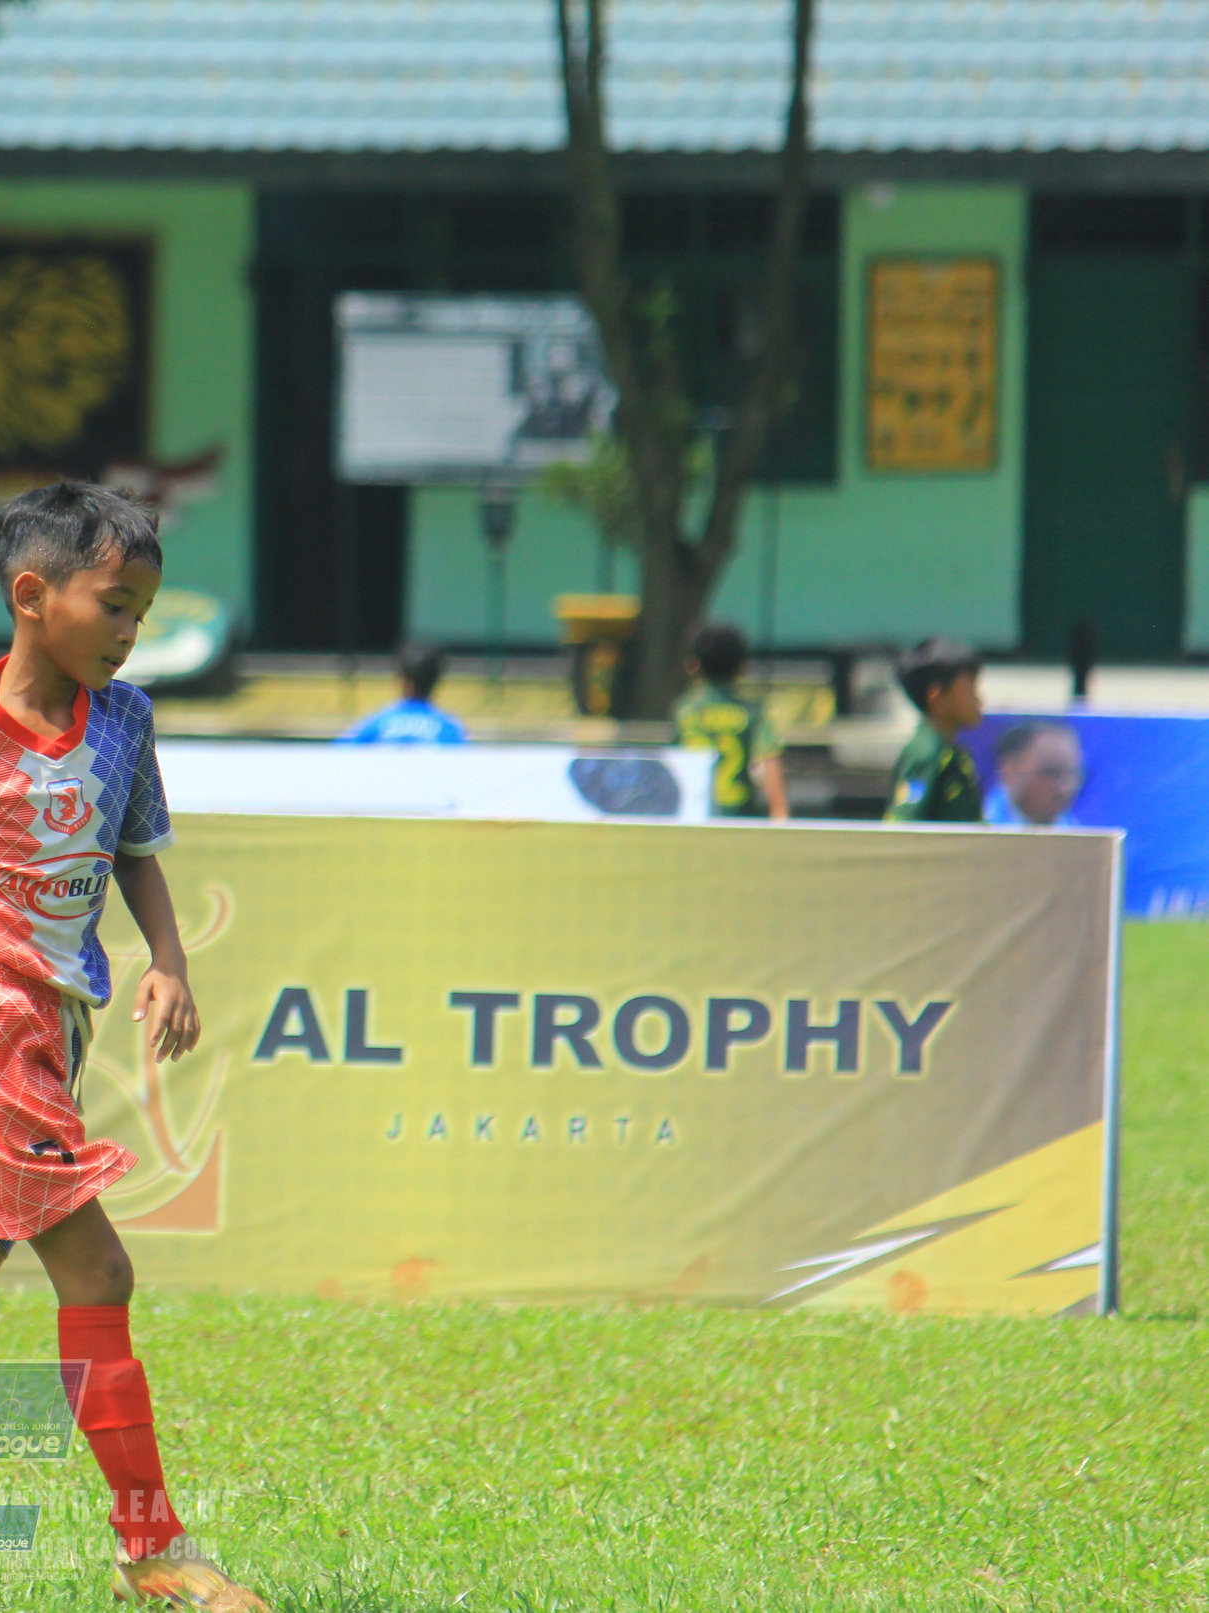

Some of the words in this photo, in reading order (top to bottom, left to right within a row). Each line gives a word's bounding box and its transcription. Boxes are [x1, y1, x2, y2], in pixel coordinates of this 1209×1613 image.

[252, 987, 403, 1063] AL
[450, 990, 954, 1075] TROPHY
[384, 1111, 679, 1147] JAKARTA
